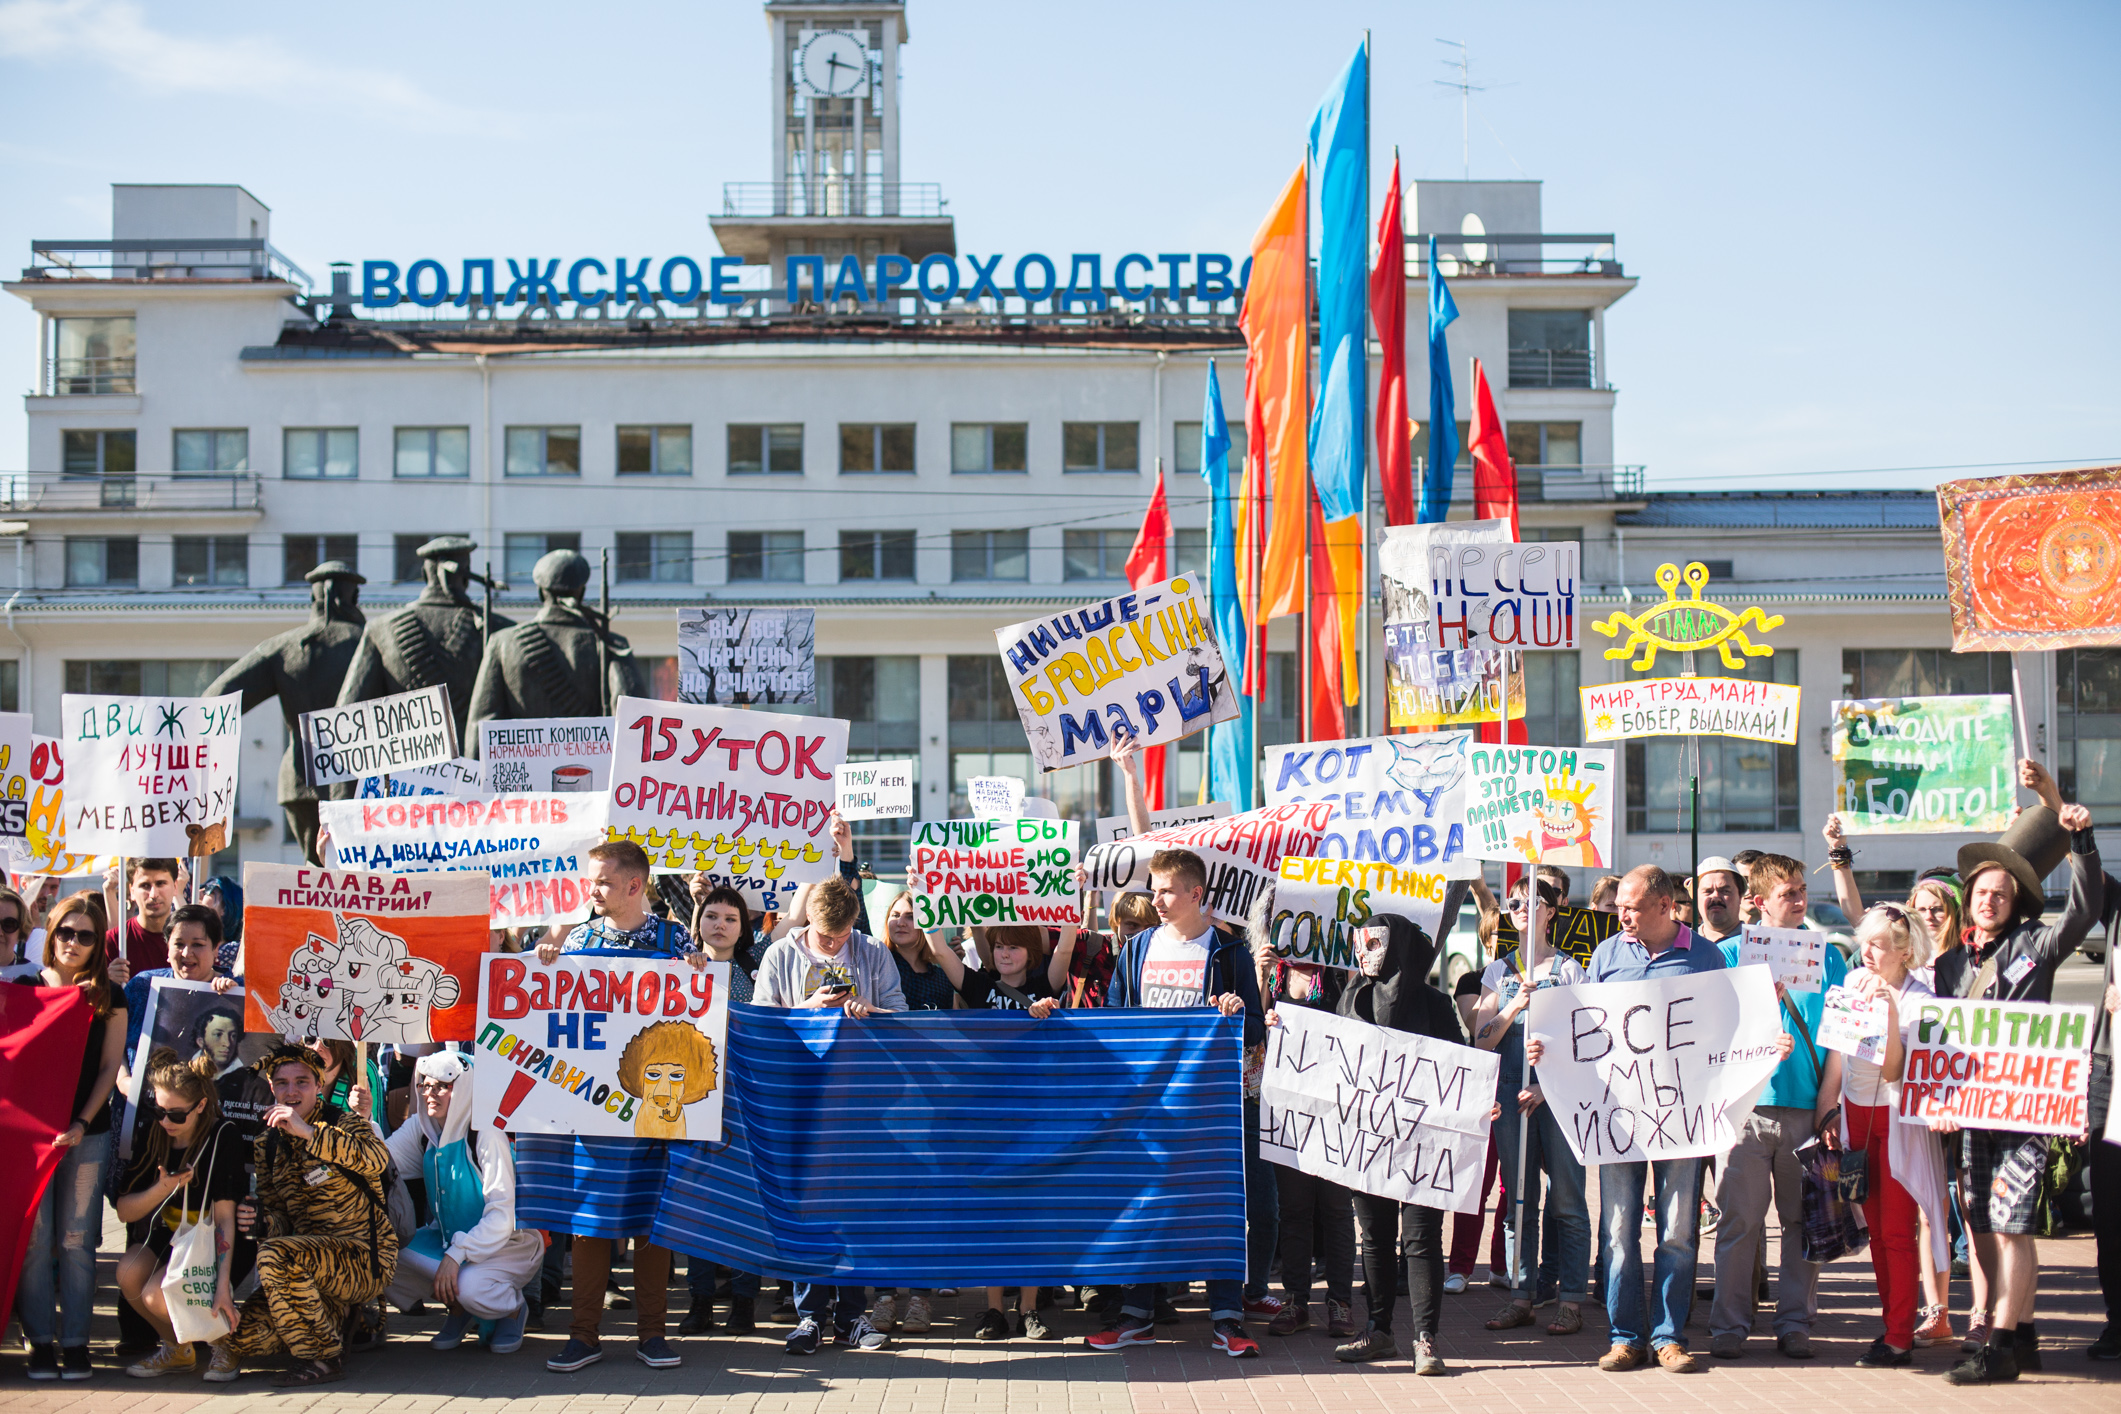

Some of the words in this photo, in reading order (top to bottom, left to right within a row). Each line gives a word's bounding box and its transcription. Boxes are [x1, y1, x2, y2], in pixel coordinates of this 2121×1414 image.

[361, 256, 744, 306] ВОЛЖСКОЕ
[751, 619, 785, 641] ВСЕ
[697, 646, 800, 669] ОБРЕЧЕНЫ
[682, 672, 708, 694] НА
[1591, 689, 1641, 710] МИР,
[1644, 682, 1707, 704] ТРУД,
[1709, 682, 1768, 707] МАЙ!
[315, 709, 367, 750] ВСЯ
[374, 695, 443, 739] ВЛАСТЬ
[489, 728, 544, 745] РЕЦЕПТ
[551, 726, 610, 744] КОМПОТА
[1622, 706, 1682, 733] БОБЁР,
[1690, 706, 1788, 738] ВЫДЫХАЙ!
[1852, 713, 1992, 745] ЗАХОДИТЕ
[115, 743, 218, 772] ЛУЧШЕ,
[314, 731, 446, 778] ФОТОПЛЁНКАМ
[490, 743, 560, 759] НОРМАЛЬНОГО
[563, 741, 613, 756] ЧЕЛОВЕКА
[629, 715, 683, 762] 15
[681, 726, 832, 780] УТОК
[1471, 749, 1578, 776] ПЛУТОН
[1895, 749, 1953, 773] НАМ
[138, 774, 189, 795] ЧЕМ
[843, 770, 877, 786] ТРАВУ
[1276, 744, 1372, 792] КОТ
[77, 775, 232, 833] МЕДВЕЖУХА
[843, 792, 876, 808] ГРИБЫ
[1290, 786, 1445, 820] ЕМУ
[1480, 776, 1517, 798] ЭТО
[362, 798, 569, 832] КОРПОРАТИВ
[615, 776, 836, 838] ОРГАНИЗАТОРУ
[1467, 789, 1544, 826] ПЛАНЕТА
[913, 819, 1001, 848] ЛУЧШЕ
[1016, 818, 1069, 843] БЫ
[1318, 823, 1464, 865] ОЛОВА
[338, 837, 540, 869] ИНДИВИДУАЛЬНОГО
[1036, 847, 1071, 867] НО
[1086, 843, 1136, 889] ЧТО
[298, 869, 411, 896] СЛАВА
[925, 871, 1030, 895] РАНЬШЕ
[1028, 869, 1076, 897] УЖЕ
[1280, 856, 1447, 904] EVERYTHING
[277, 889, 433, 912] ПСИХИАТРИИ!
[1336, 885, 1373, 927] IS
[547, 1012, 608, 1050] НЕ
[1572, 996, 1696, 1062] ВСЕ
[1917, 1004, 2087, 1050] РАНТИН
[477, 1022, 637, 1122] ПОНРАВИЛОСЬ
[1603, 1057, 1685, 1107] МЫ
[1906, 1049, 2081, 1094] ПОСЛЕДНЕЕ
[1899, 1081, 2087, 1129] ПРЕДУПРЕЖДЕНИЕ
[1574, 1099, 1728, 1159] ЙОЖИК
